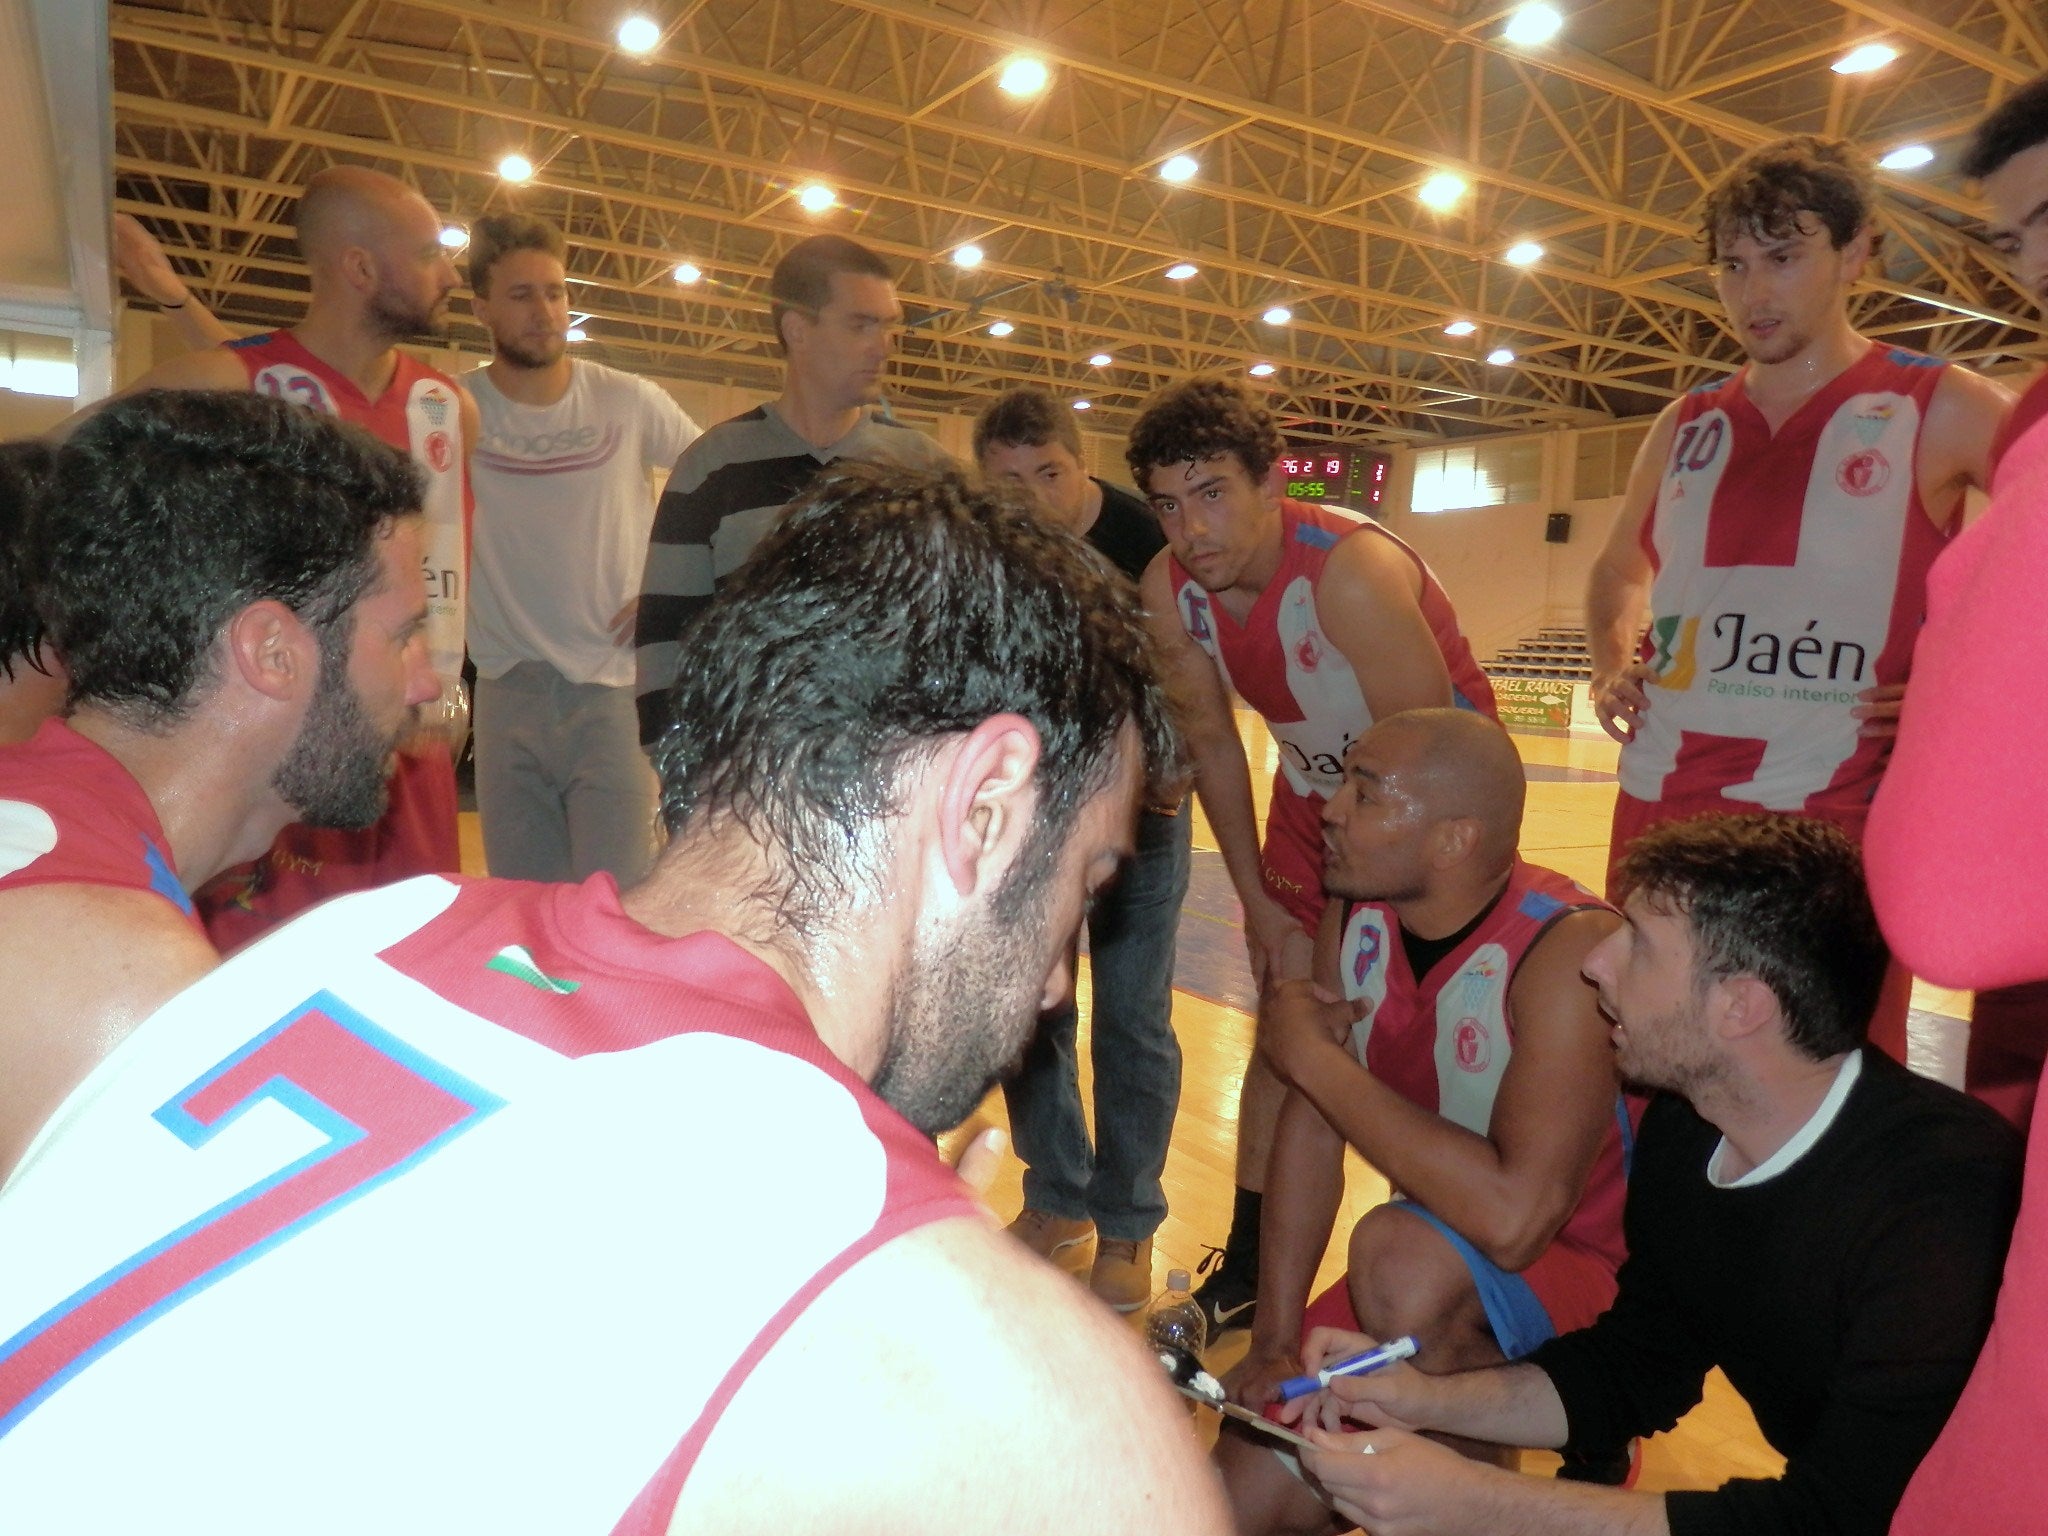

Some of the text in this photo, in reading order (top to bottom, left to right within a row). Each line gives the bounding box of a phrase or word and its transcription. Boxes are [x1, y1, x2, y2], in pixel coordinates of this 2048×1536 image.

[1671, 418, 1724, 475] 10
[1303, 461, 1313, 473] 2
[1287, 482, 1325, 497] 05:55
[1709, 612, 1866, 682] Jaén
[1524, 681, 1572, 696] RAMOS
[1707, 678, 1776, 699] Paraíso
[0, 987, 512, 1442] 7
